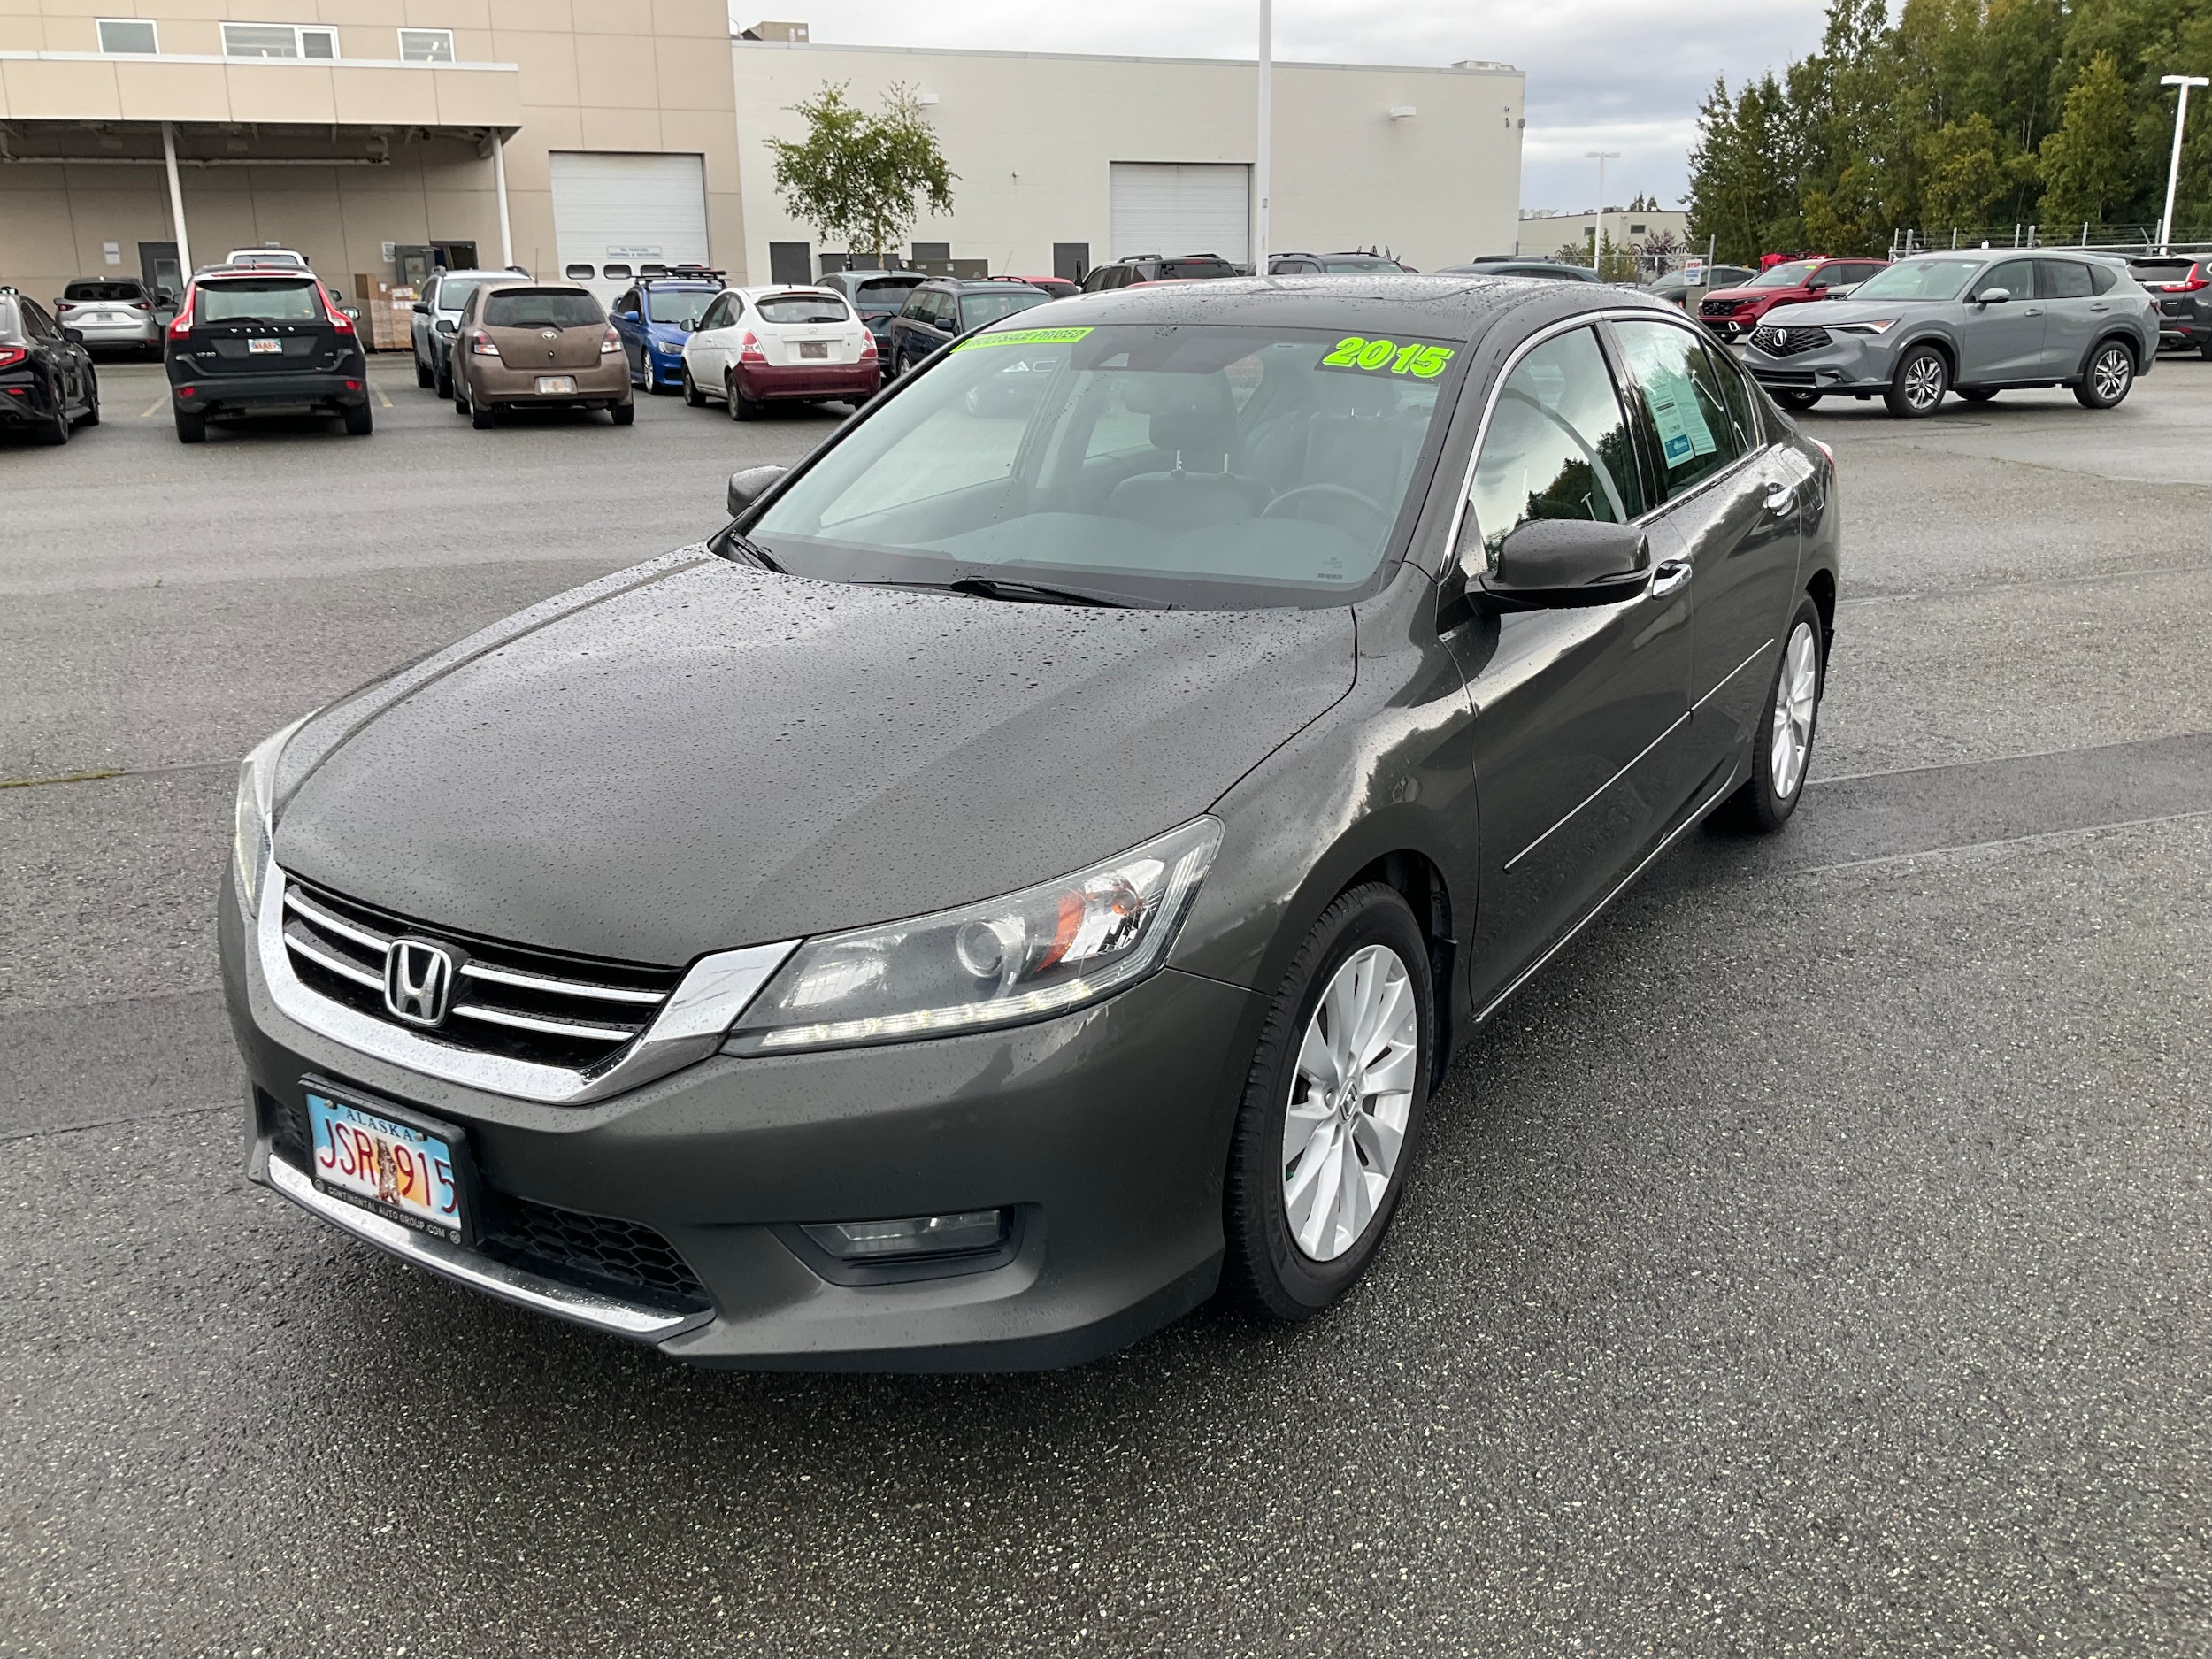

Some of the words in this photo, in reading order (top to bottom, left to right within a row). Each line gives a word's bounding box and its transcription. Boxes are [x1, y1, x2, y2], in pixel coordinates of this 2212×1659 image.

[1030, 330, 1086, 340] PRICED
[1322, 337, 1455, 378] 2015
[346, 1108, 414, 1141] ALASKA
[319, 1117, 376, 1186] JSR
[394, 1144, 457, 1213] 915
[327, 1187, 378, 1212] CONTINENTAL
[379, 1207, 398, 1220] AUTO
[400, 1214, 425, 1231] GROUP
